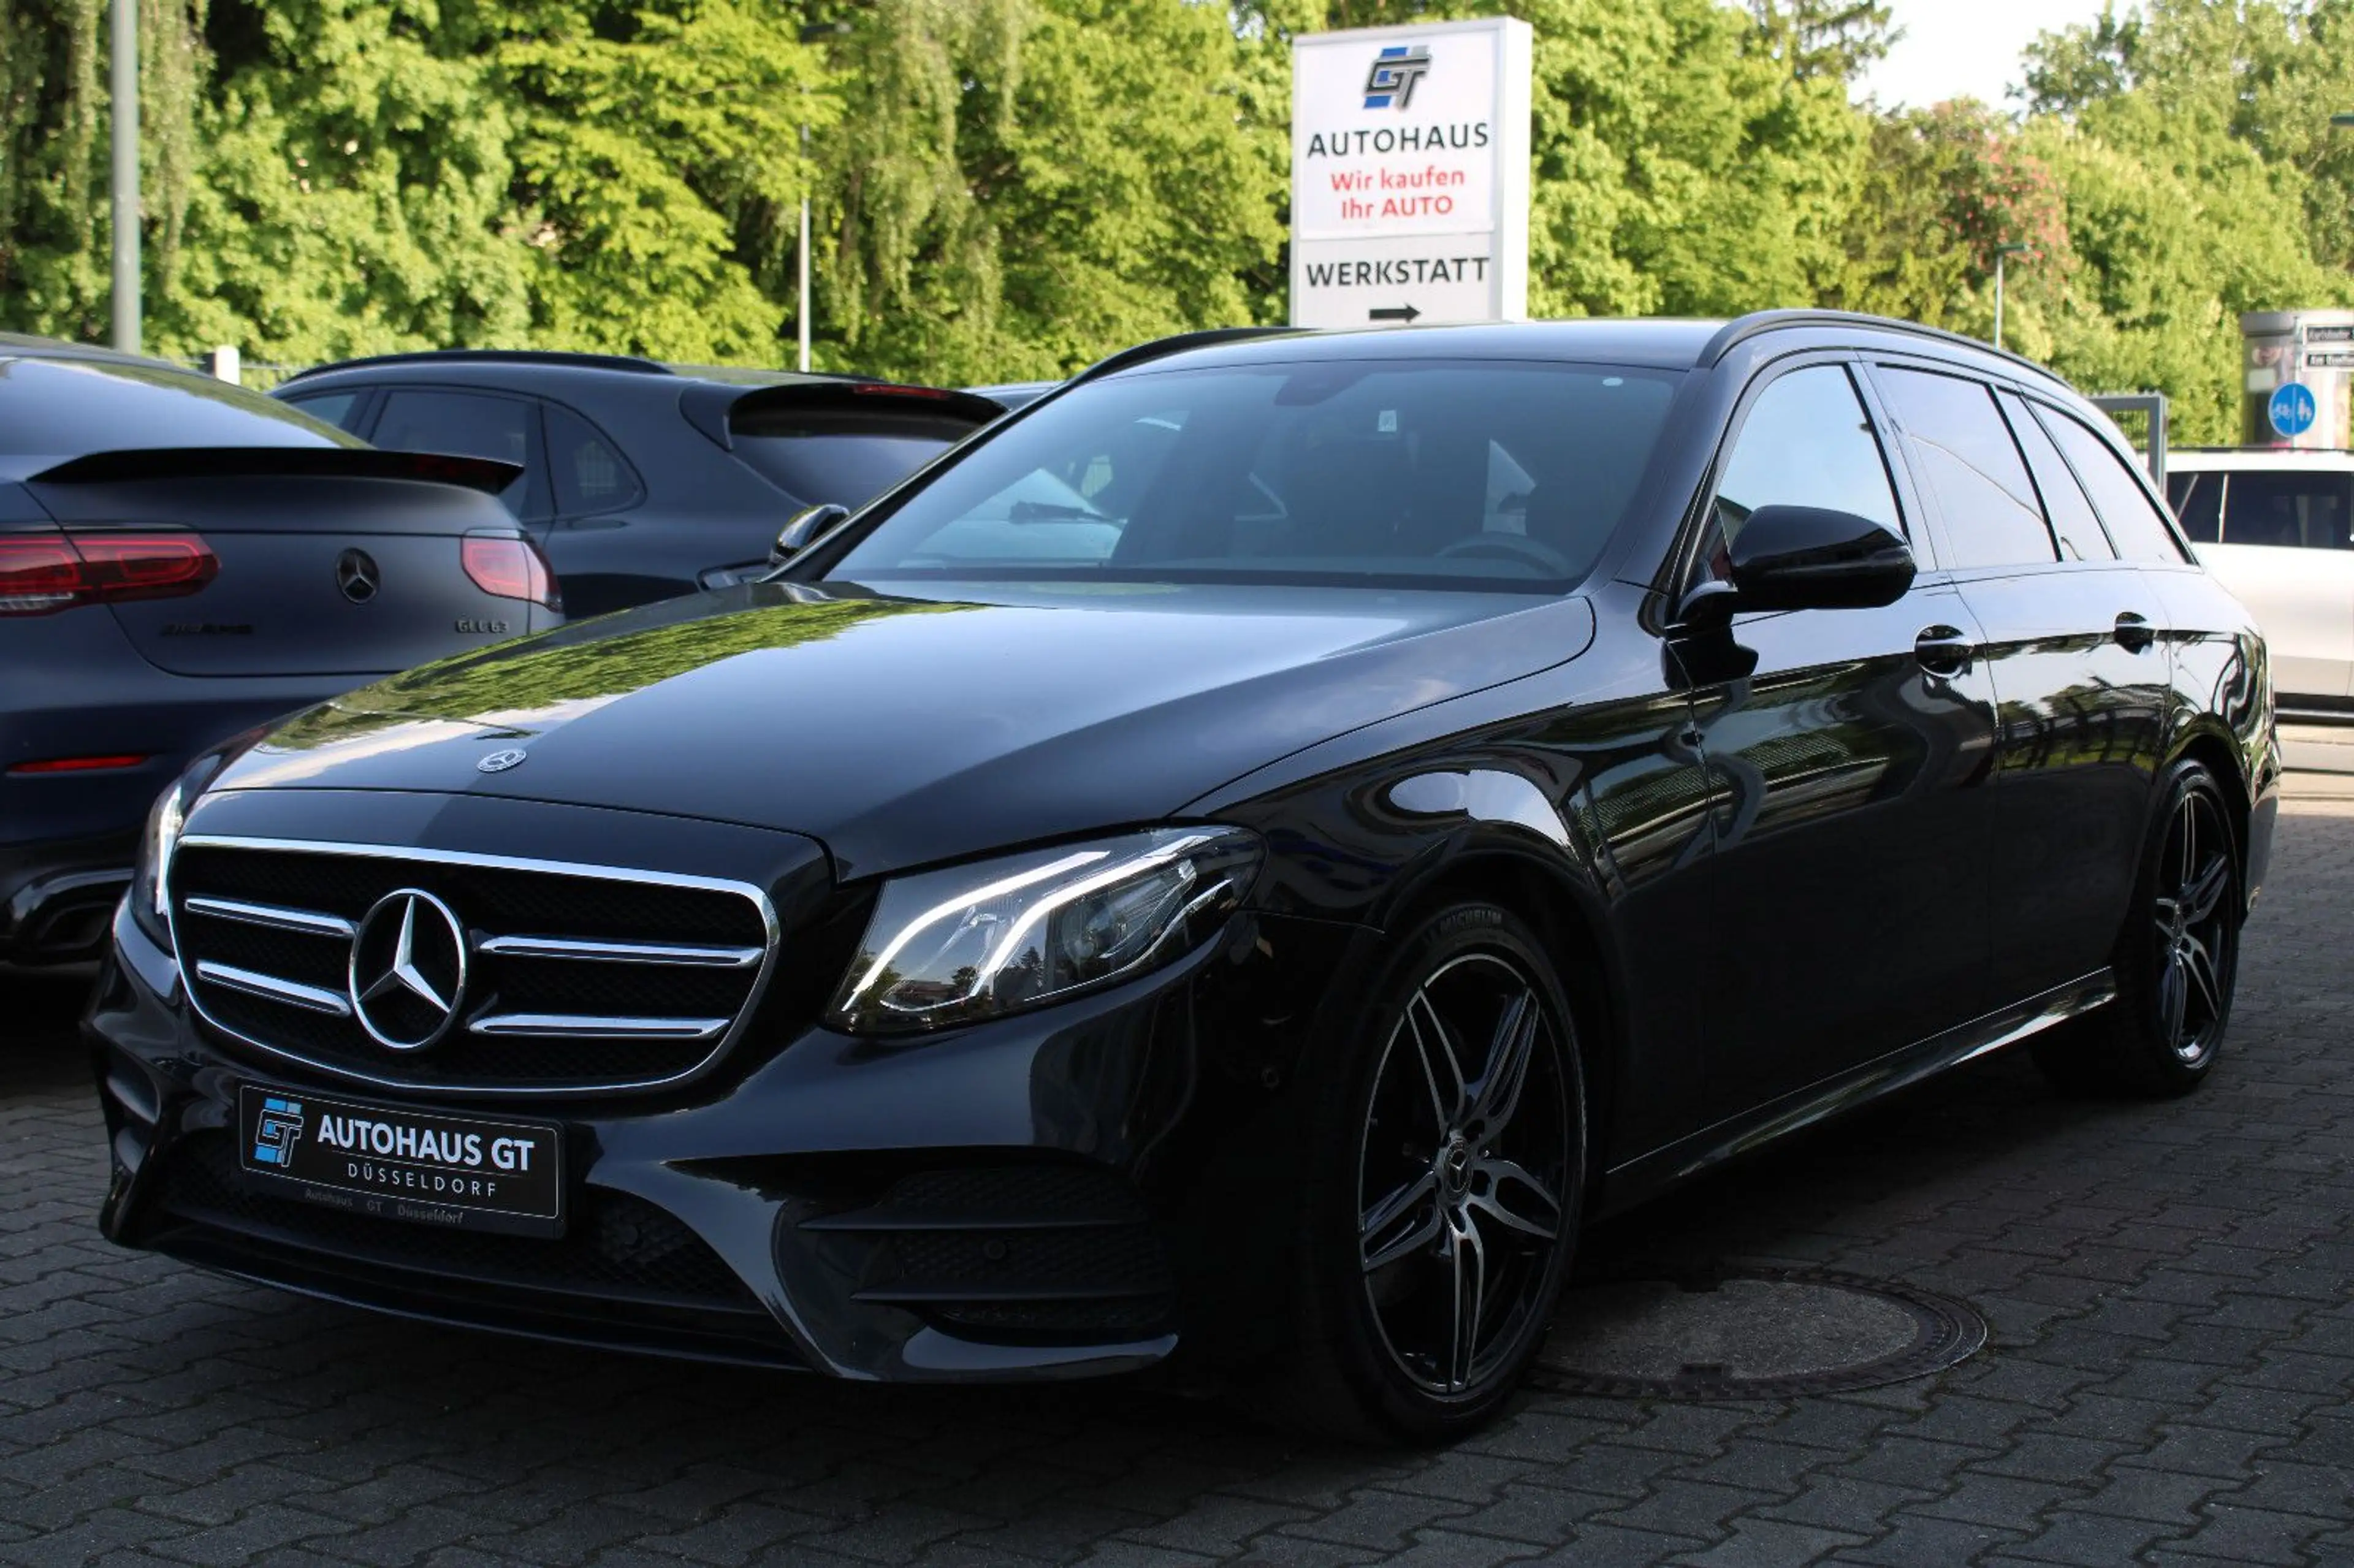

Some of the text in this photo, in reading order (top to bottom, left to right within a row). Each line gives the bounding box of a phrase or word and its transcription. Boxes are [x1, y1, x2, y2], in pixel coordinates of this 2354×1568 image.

[1307, 123, 1489, 159] AUTOHAUS
[1330, 165, 1465, 192] Wir kaufen
[1342, 196, 1453, 220] Ihr AUTO
[1306, 257, 1490, 287] WERKSTATT
[317, 1114, 535, 1171] AUTOHAUS GT
[348, 1163, 497, 1197] DÜSSELDORF
